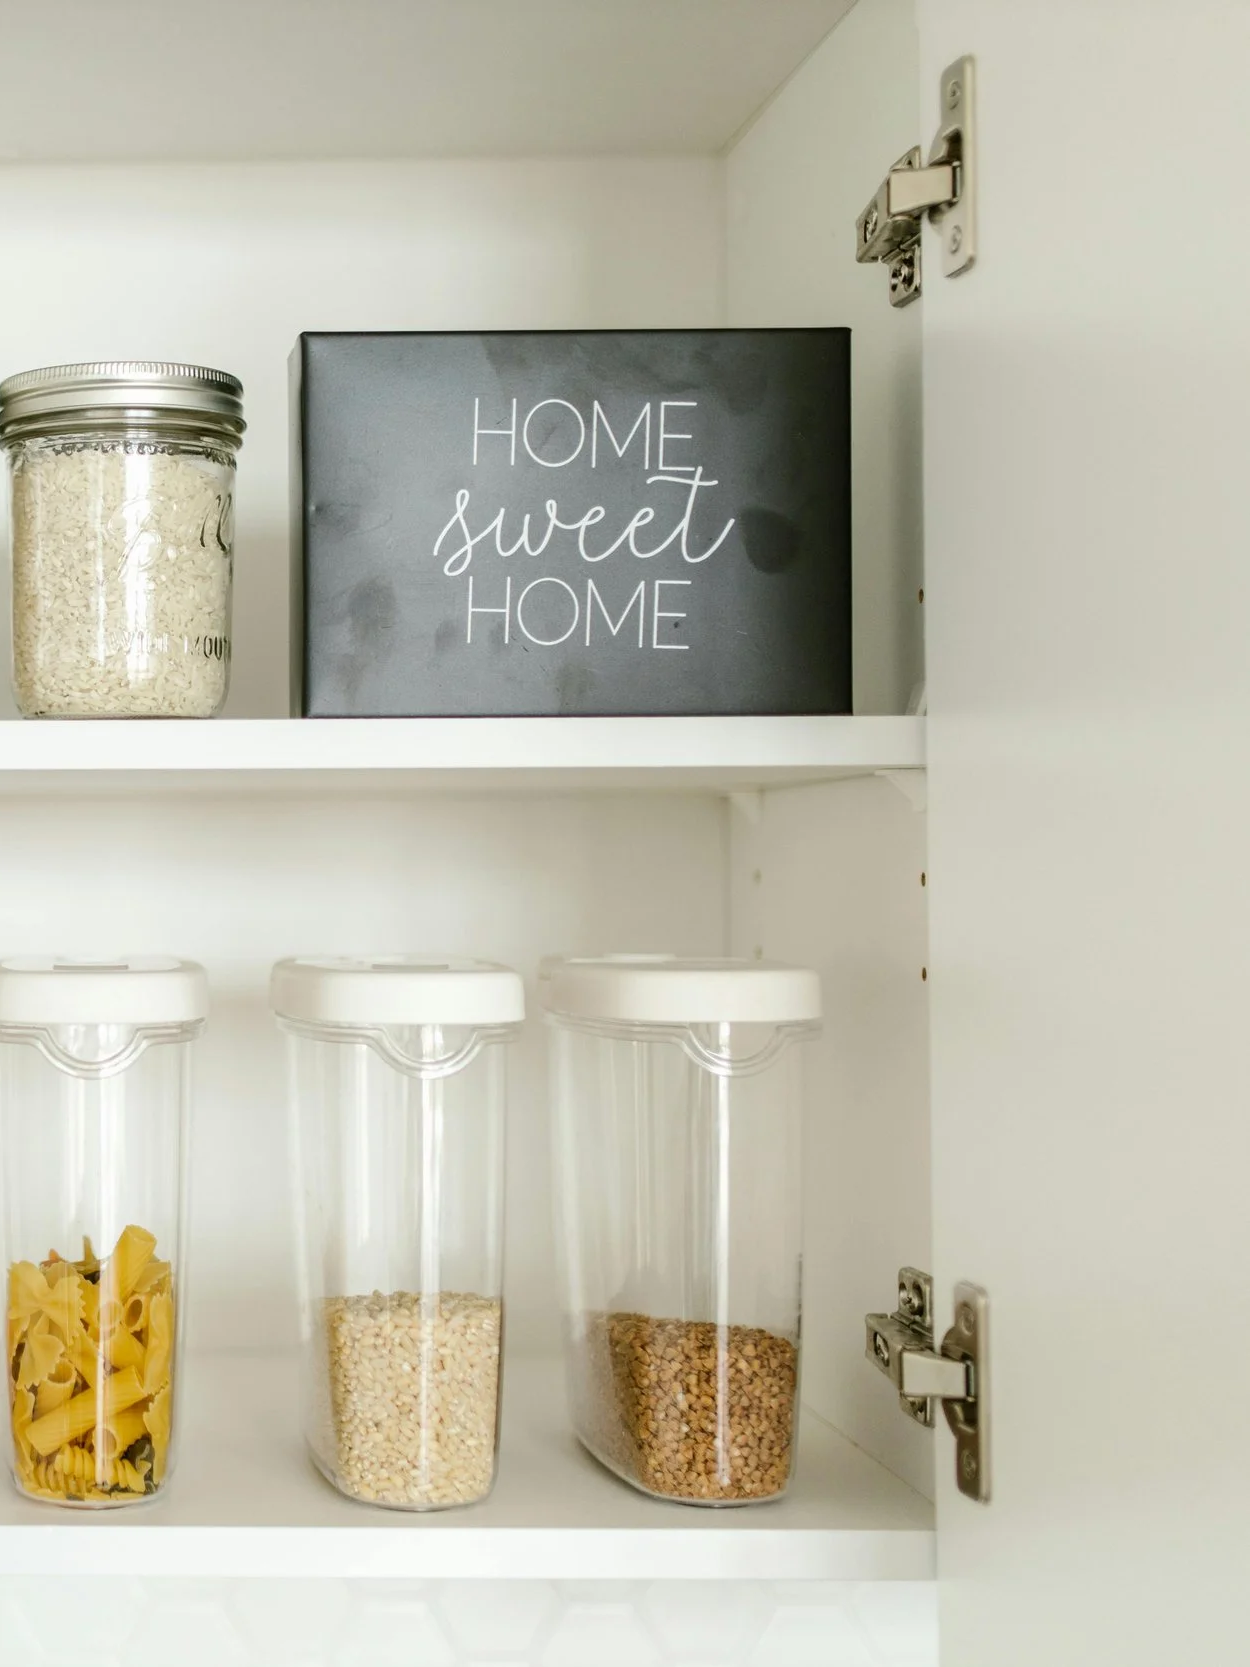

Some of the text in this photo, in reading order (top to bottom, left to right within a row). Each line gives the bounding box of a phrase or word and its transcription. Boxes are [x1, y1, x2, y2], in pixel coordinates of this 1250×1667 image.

[473, 397, 698, 472] HOME
[433, 466, 736, 576] sweet
[466, 575, 692, 650] HOME
